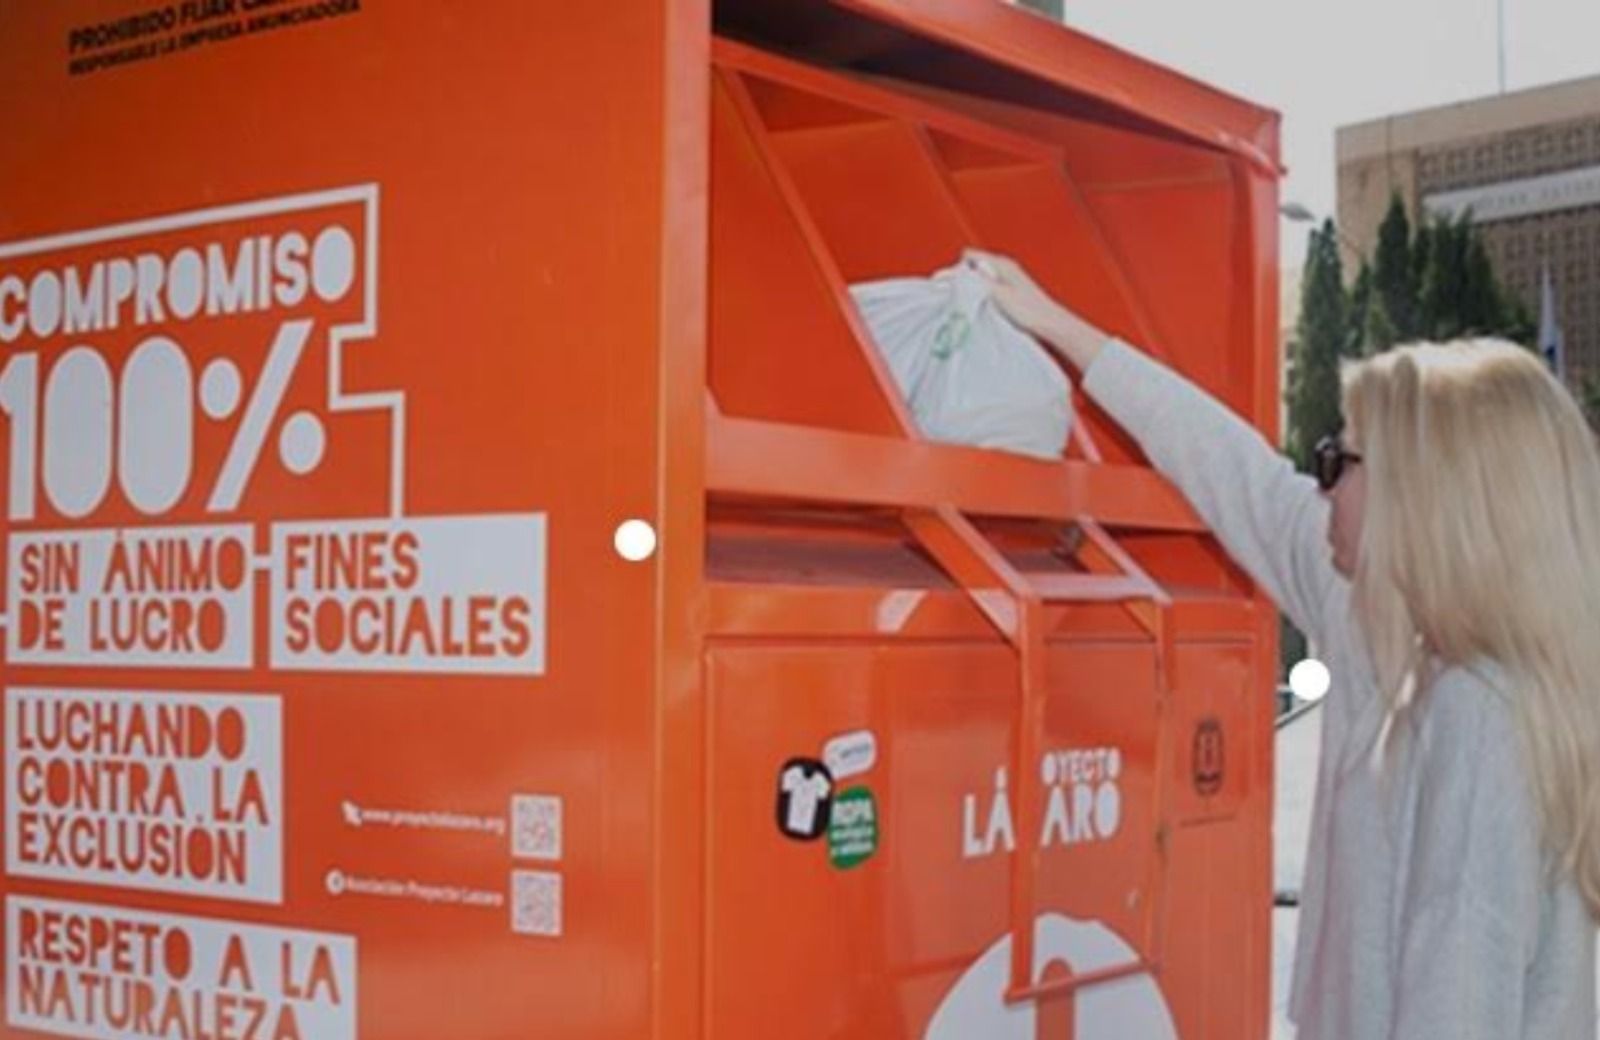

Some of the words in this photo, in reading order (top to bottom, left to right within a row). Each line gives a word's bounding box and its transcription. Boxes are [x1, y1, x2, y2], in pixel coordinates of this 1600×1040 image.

[69, 5, 176, 54] PROHIBIDO
[0, 225, 355, 341] COMPROMISO
[0, 319, 326, 521] 100%
[19, 542, 81, 594] SIN
[103, 531, 245, 593] ÁNIMO
[285, 532, 419, 590] FINES
[18, 600, 64, 651] DE
[90, 598, 227, 653] LUCRO
[285, 596, 532, 656] SOCIALES
[17, 699, 245, 761] LUCHANDO
[17, 757, 184, 819] CONTRA
[212, 766, 269, 826] LA
[1036, 747, 1122, 785] OYECTO
[963, 766, 1121, 858] LÁARO
[18, 811, 246, 885] EXCLUSIÓN
[18, 908, 192, 981] RESPETO
[219, 934, 252, 991] A
[281, 940, 341, 1004] LA
[18, 964, 302, 1040] NATURALEZA
